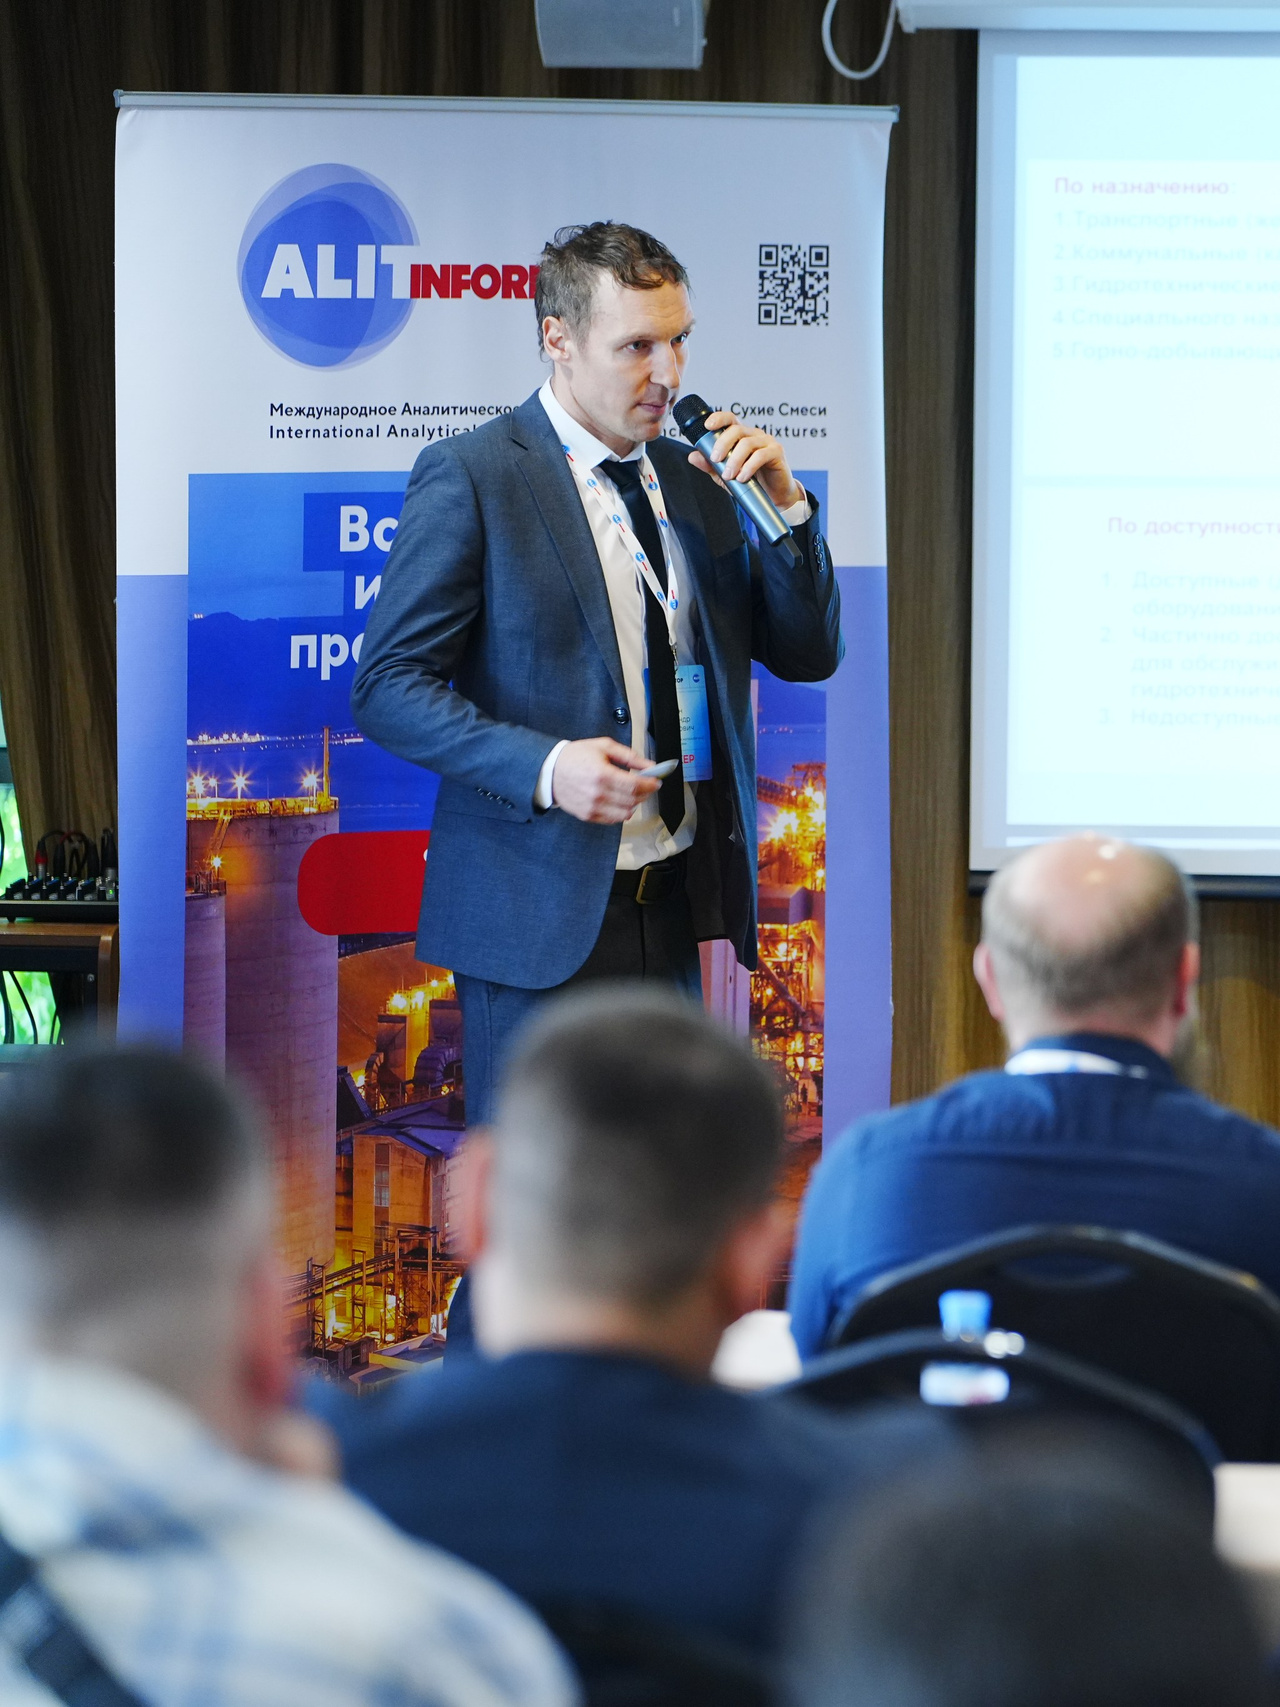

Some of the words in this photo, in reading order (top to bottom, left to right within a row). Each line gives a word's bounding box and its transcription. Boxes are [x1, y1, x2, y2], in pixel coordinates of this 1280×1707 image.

[1054, 177, 1084, 195] По
[1091, 177, 1237, 195] назначению:
[269, 402, 398, 420] Международное
[730, 402, 775, 420] Сухие
[778, 402, 828, 417] Смеси
[269, 424, 381, 440] International
[339, 504, 399, 553] Вс
[1107, 517, 1137, 537] По
